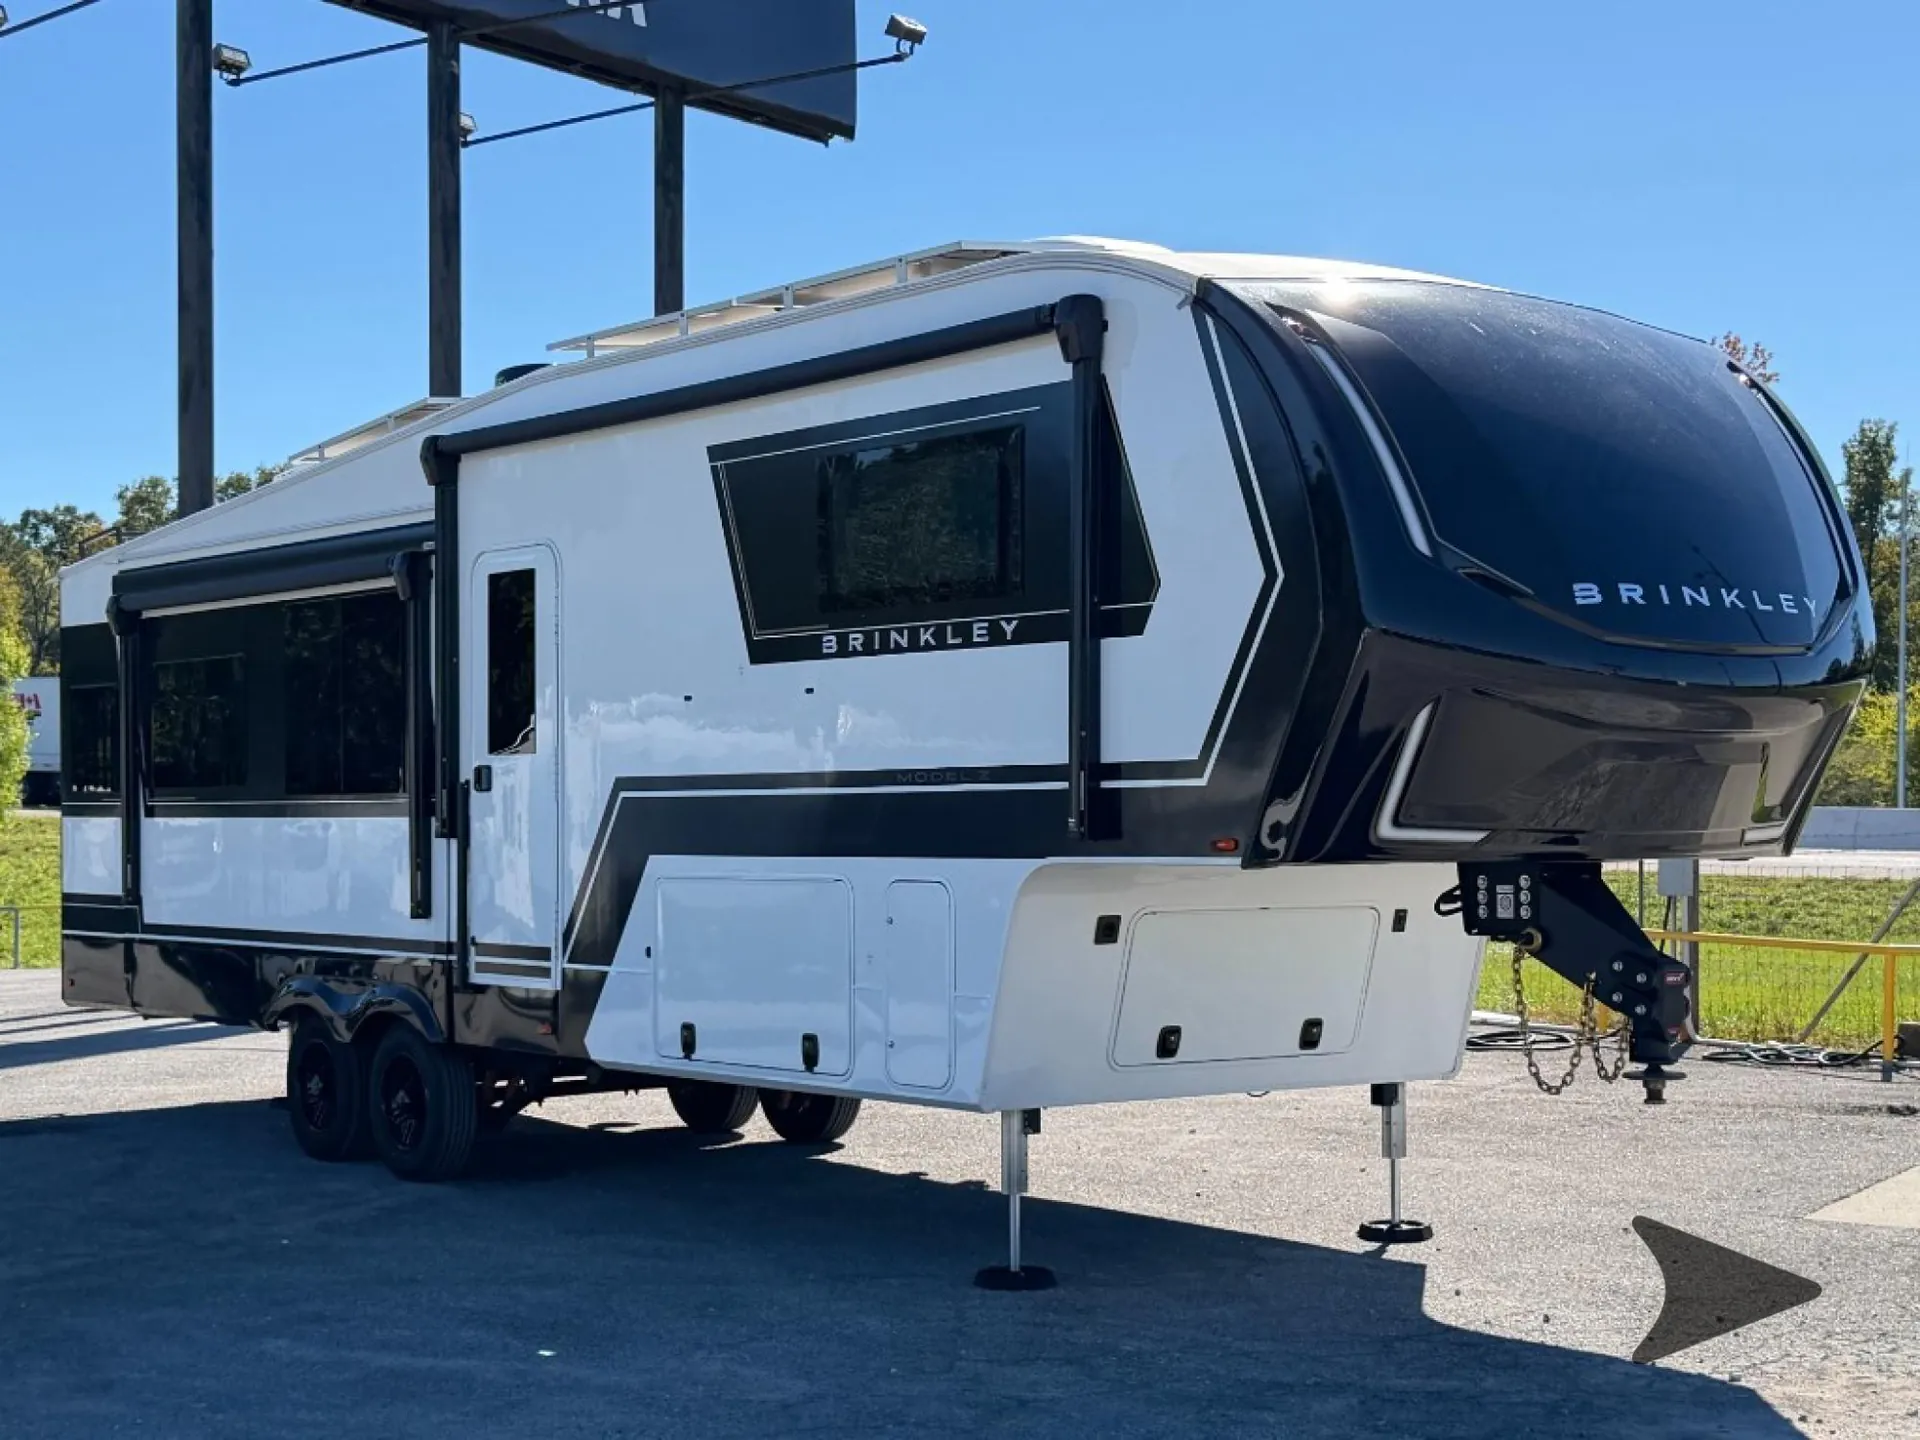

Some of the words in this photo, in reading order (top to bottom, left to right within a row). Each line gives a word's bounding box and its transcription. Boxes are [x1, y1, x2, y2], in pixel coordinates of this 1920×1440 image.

[1572, 582, 1817, 618] BRINKLEY
[821, 619, 1019, 654] BRINKLEY
[897, 770, 972, 784] MODEL
